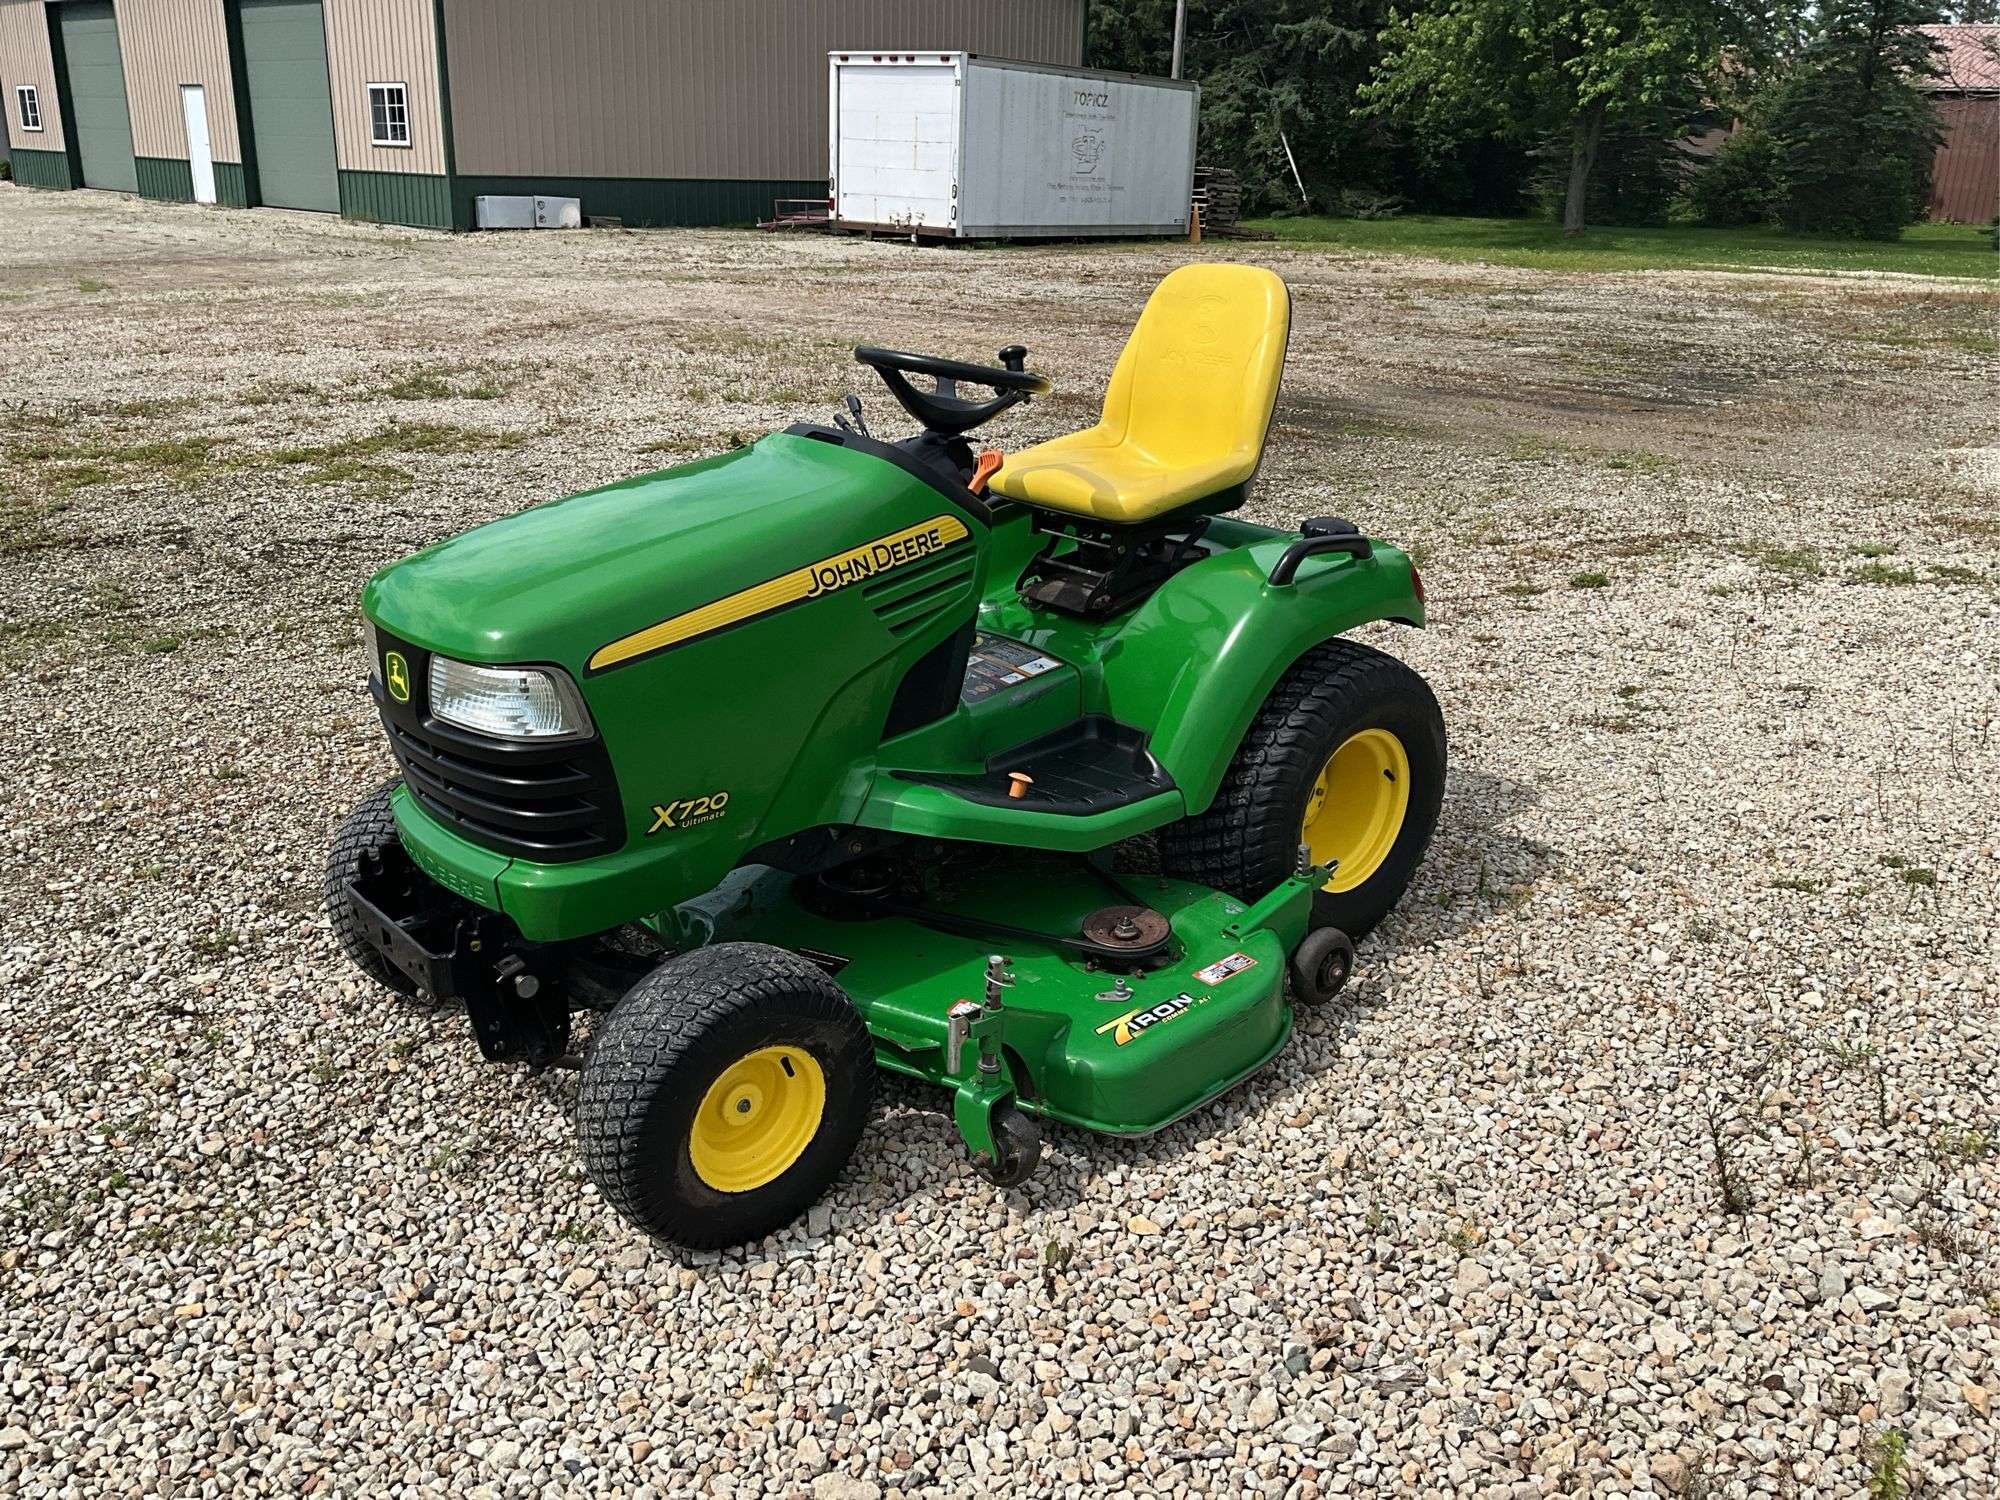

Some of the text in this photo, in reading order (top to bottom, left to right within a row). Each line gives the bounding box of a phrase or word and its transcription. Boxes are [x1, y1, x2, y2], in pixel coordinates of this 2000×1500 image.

[807, 528, 944, 595] JOHN DEERE
[647, 791, 729, 834] X720
[681, 810, 726, 828] Ultimate
